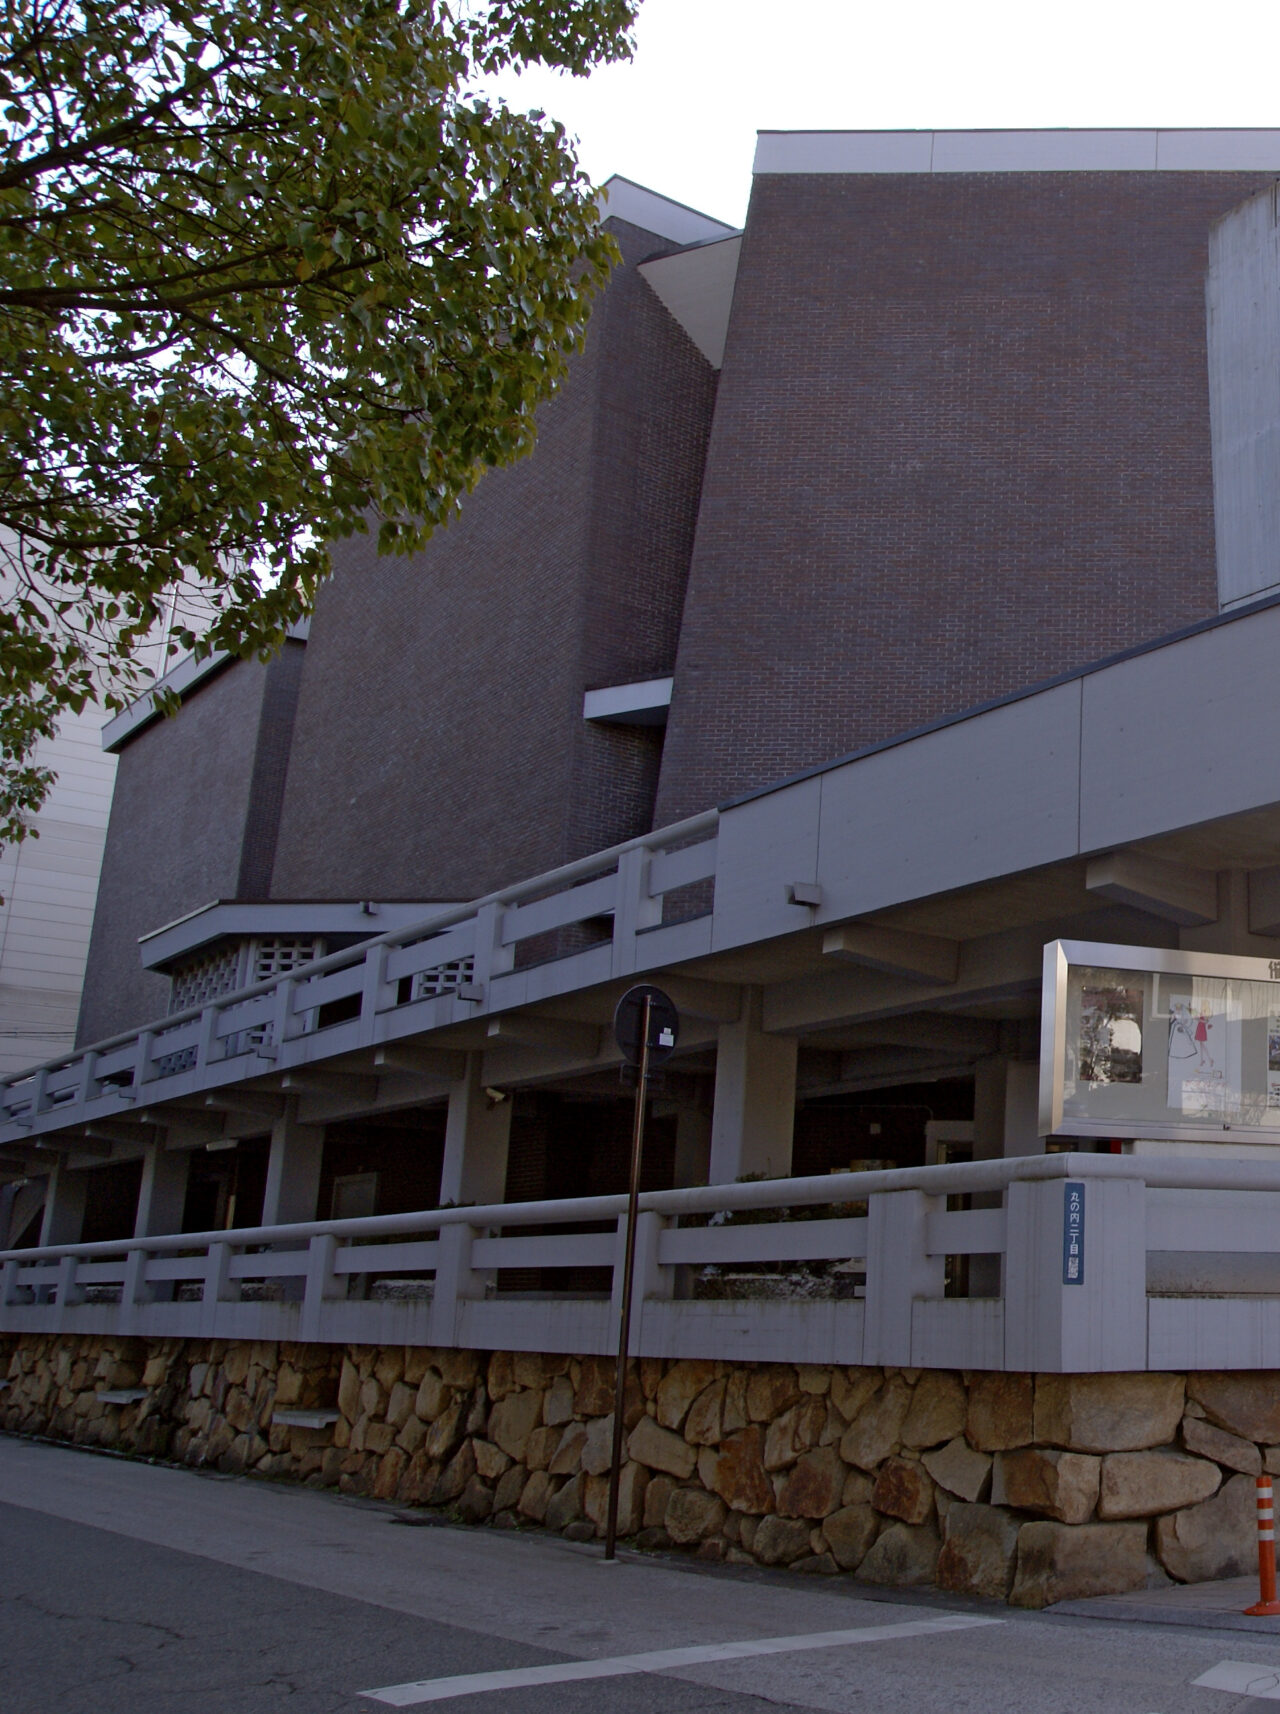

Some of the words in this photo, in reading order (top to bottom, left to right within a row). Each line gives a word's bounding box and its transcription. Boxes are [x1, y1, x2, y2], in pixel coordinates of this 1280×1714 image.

[1069, 1192, 1080, 1255] 丸の内二丁目
